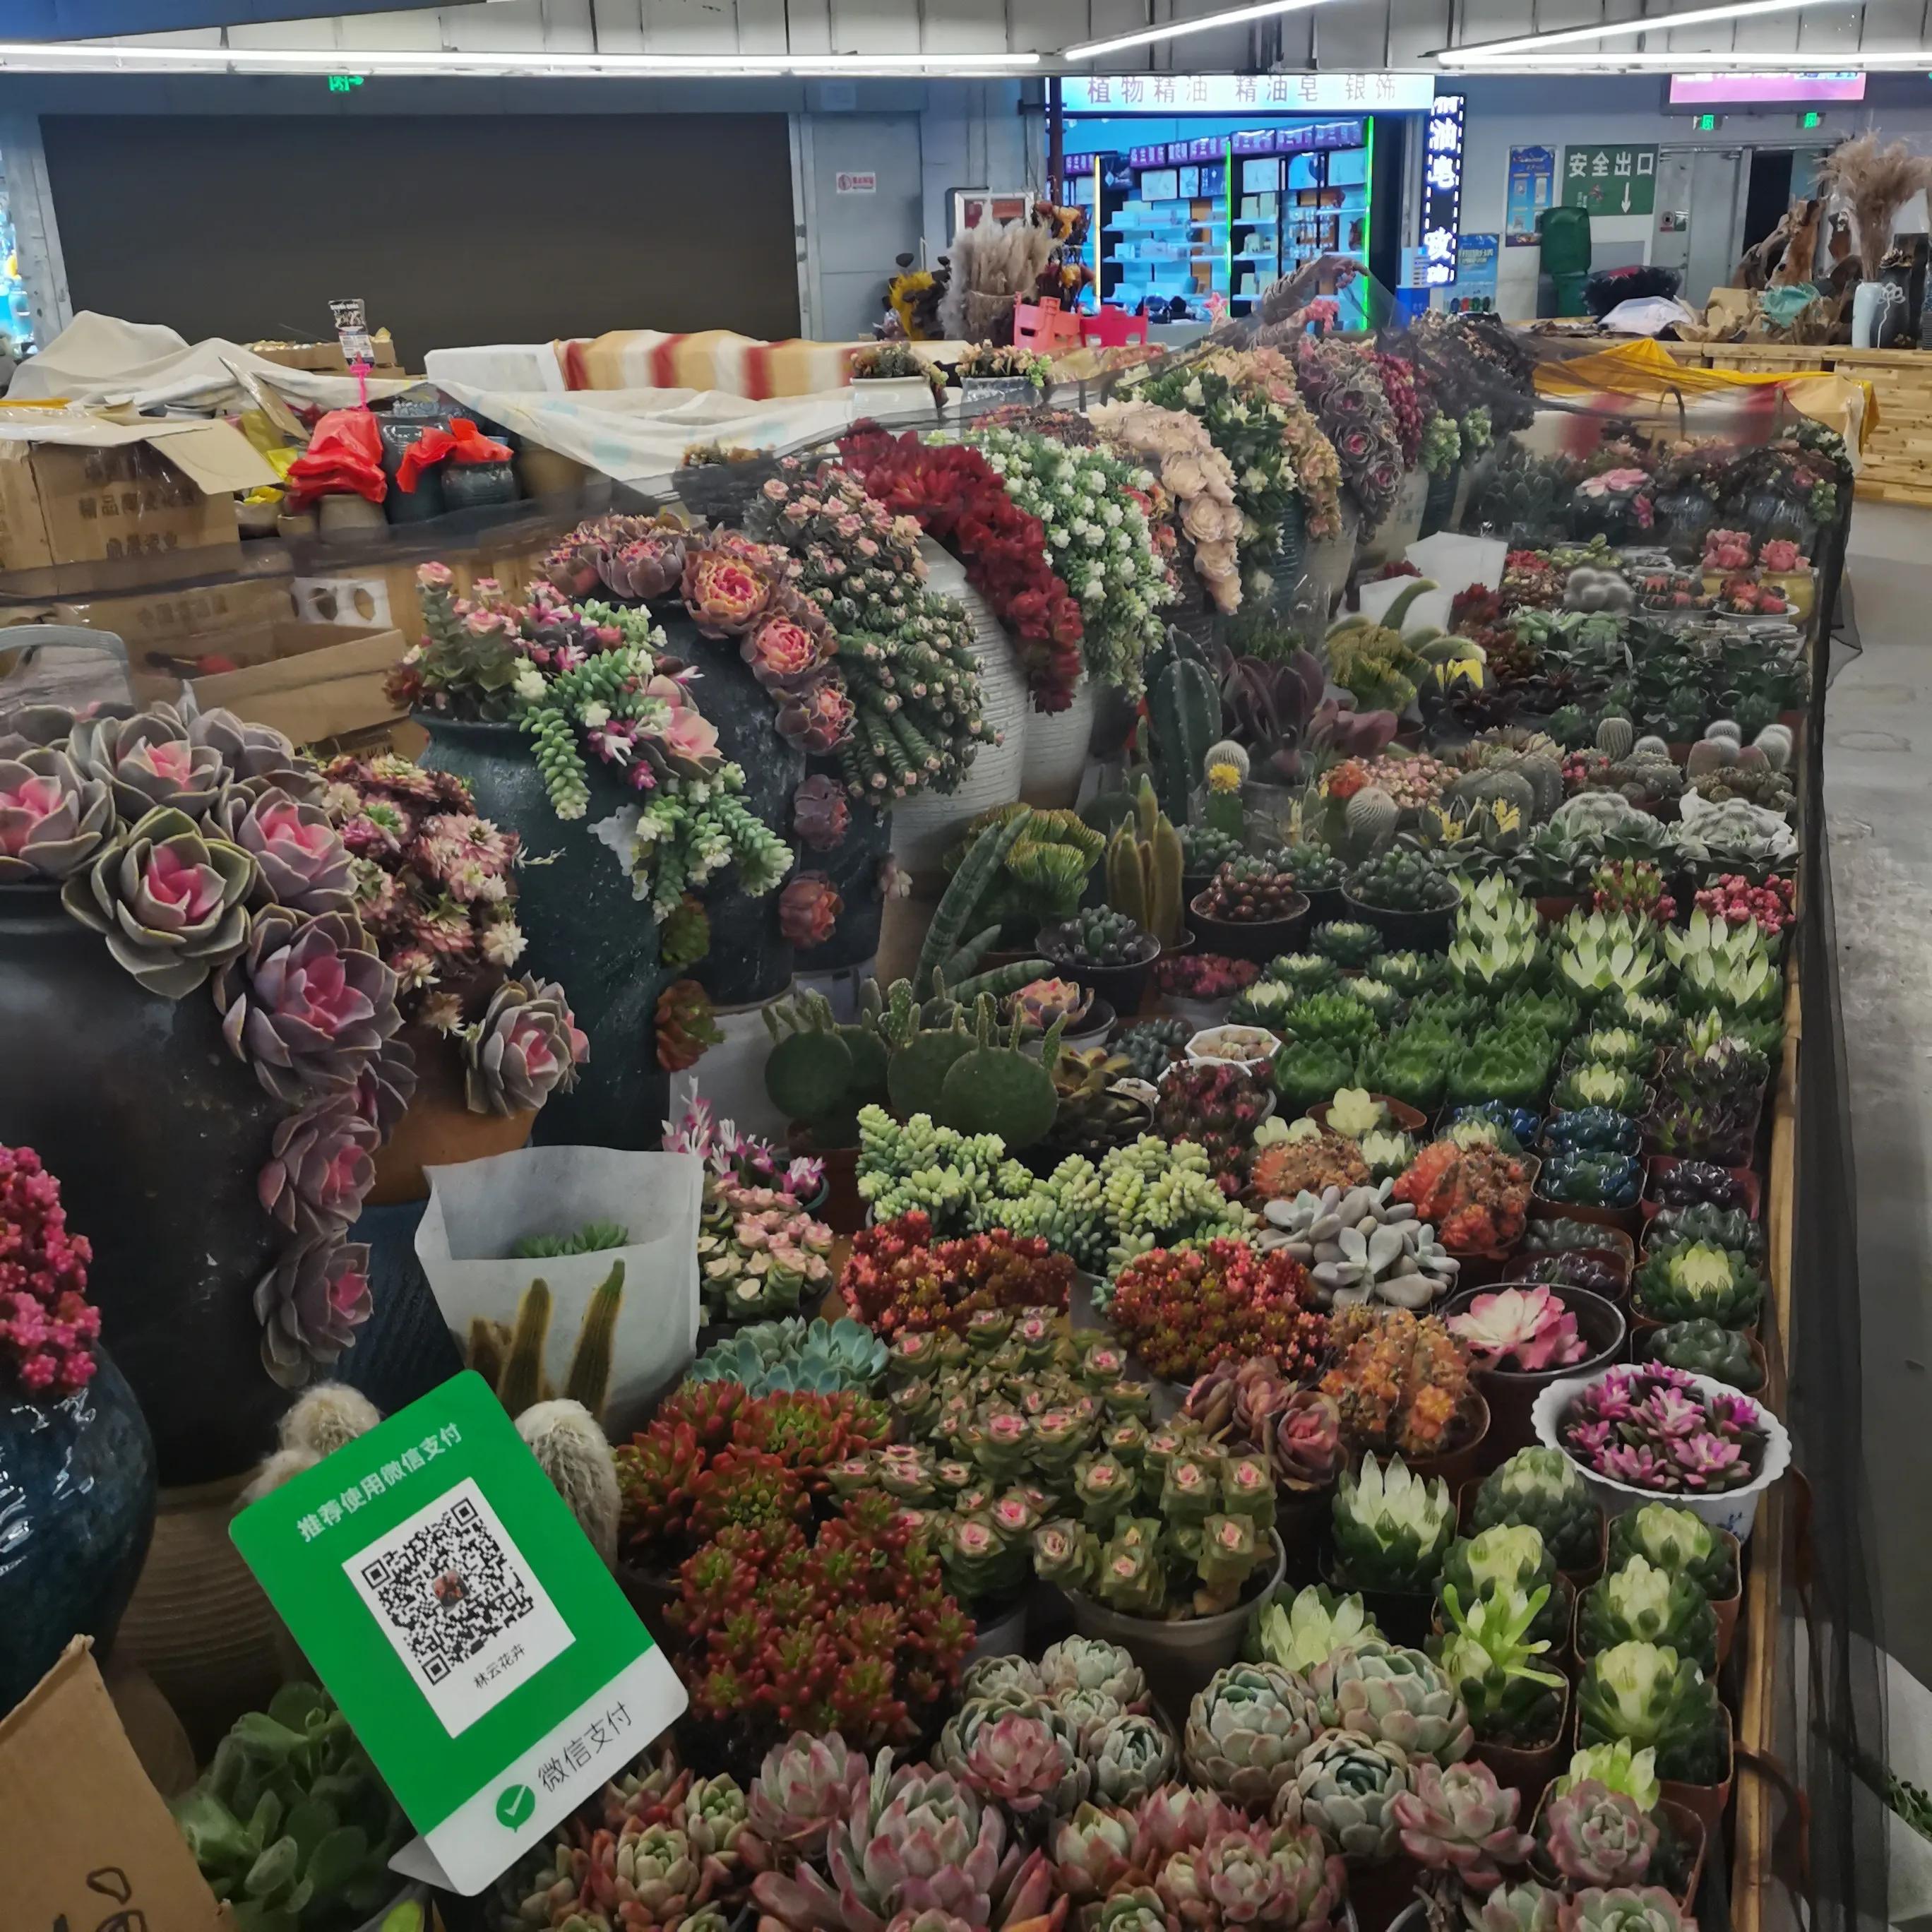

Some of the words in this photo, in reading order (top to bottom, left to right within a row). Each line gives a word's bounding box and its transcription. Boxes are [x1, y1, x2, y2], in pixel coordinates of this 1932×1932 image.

[1087, 76, 1207, 104] 植物精油
[1236, 75, 1318, 102] 精油皂
[1346, 73, 1395, 101] 银饰
[1568, 150, 1654, 177] 安全出口
[297, 1422, 462, 1542] 推荐使用微信支付
[474, 1643, 525, 1689] 林云花卉
[538, 1700, 631, 1793] 微信支付
